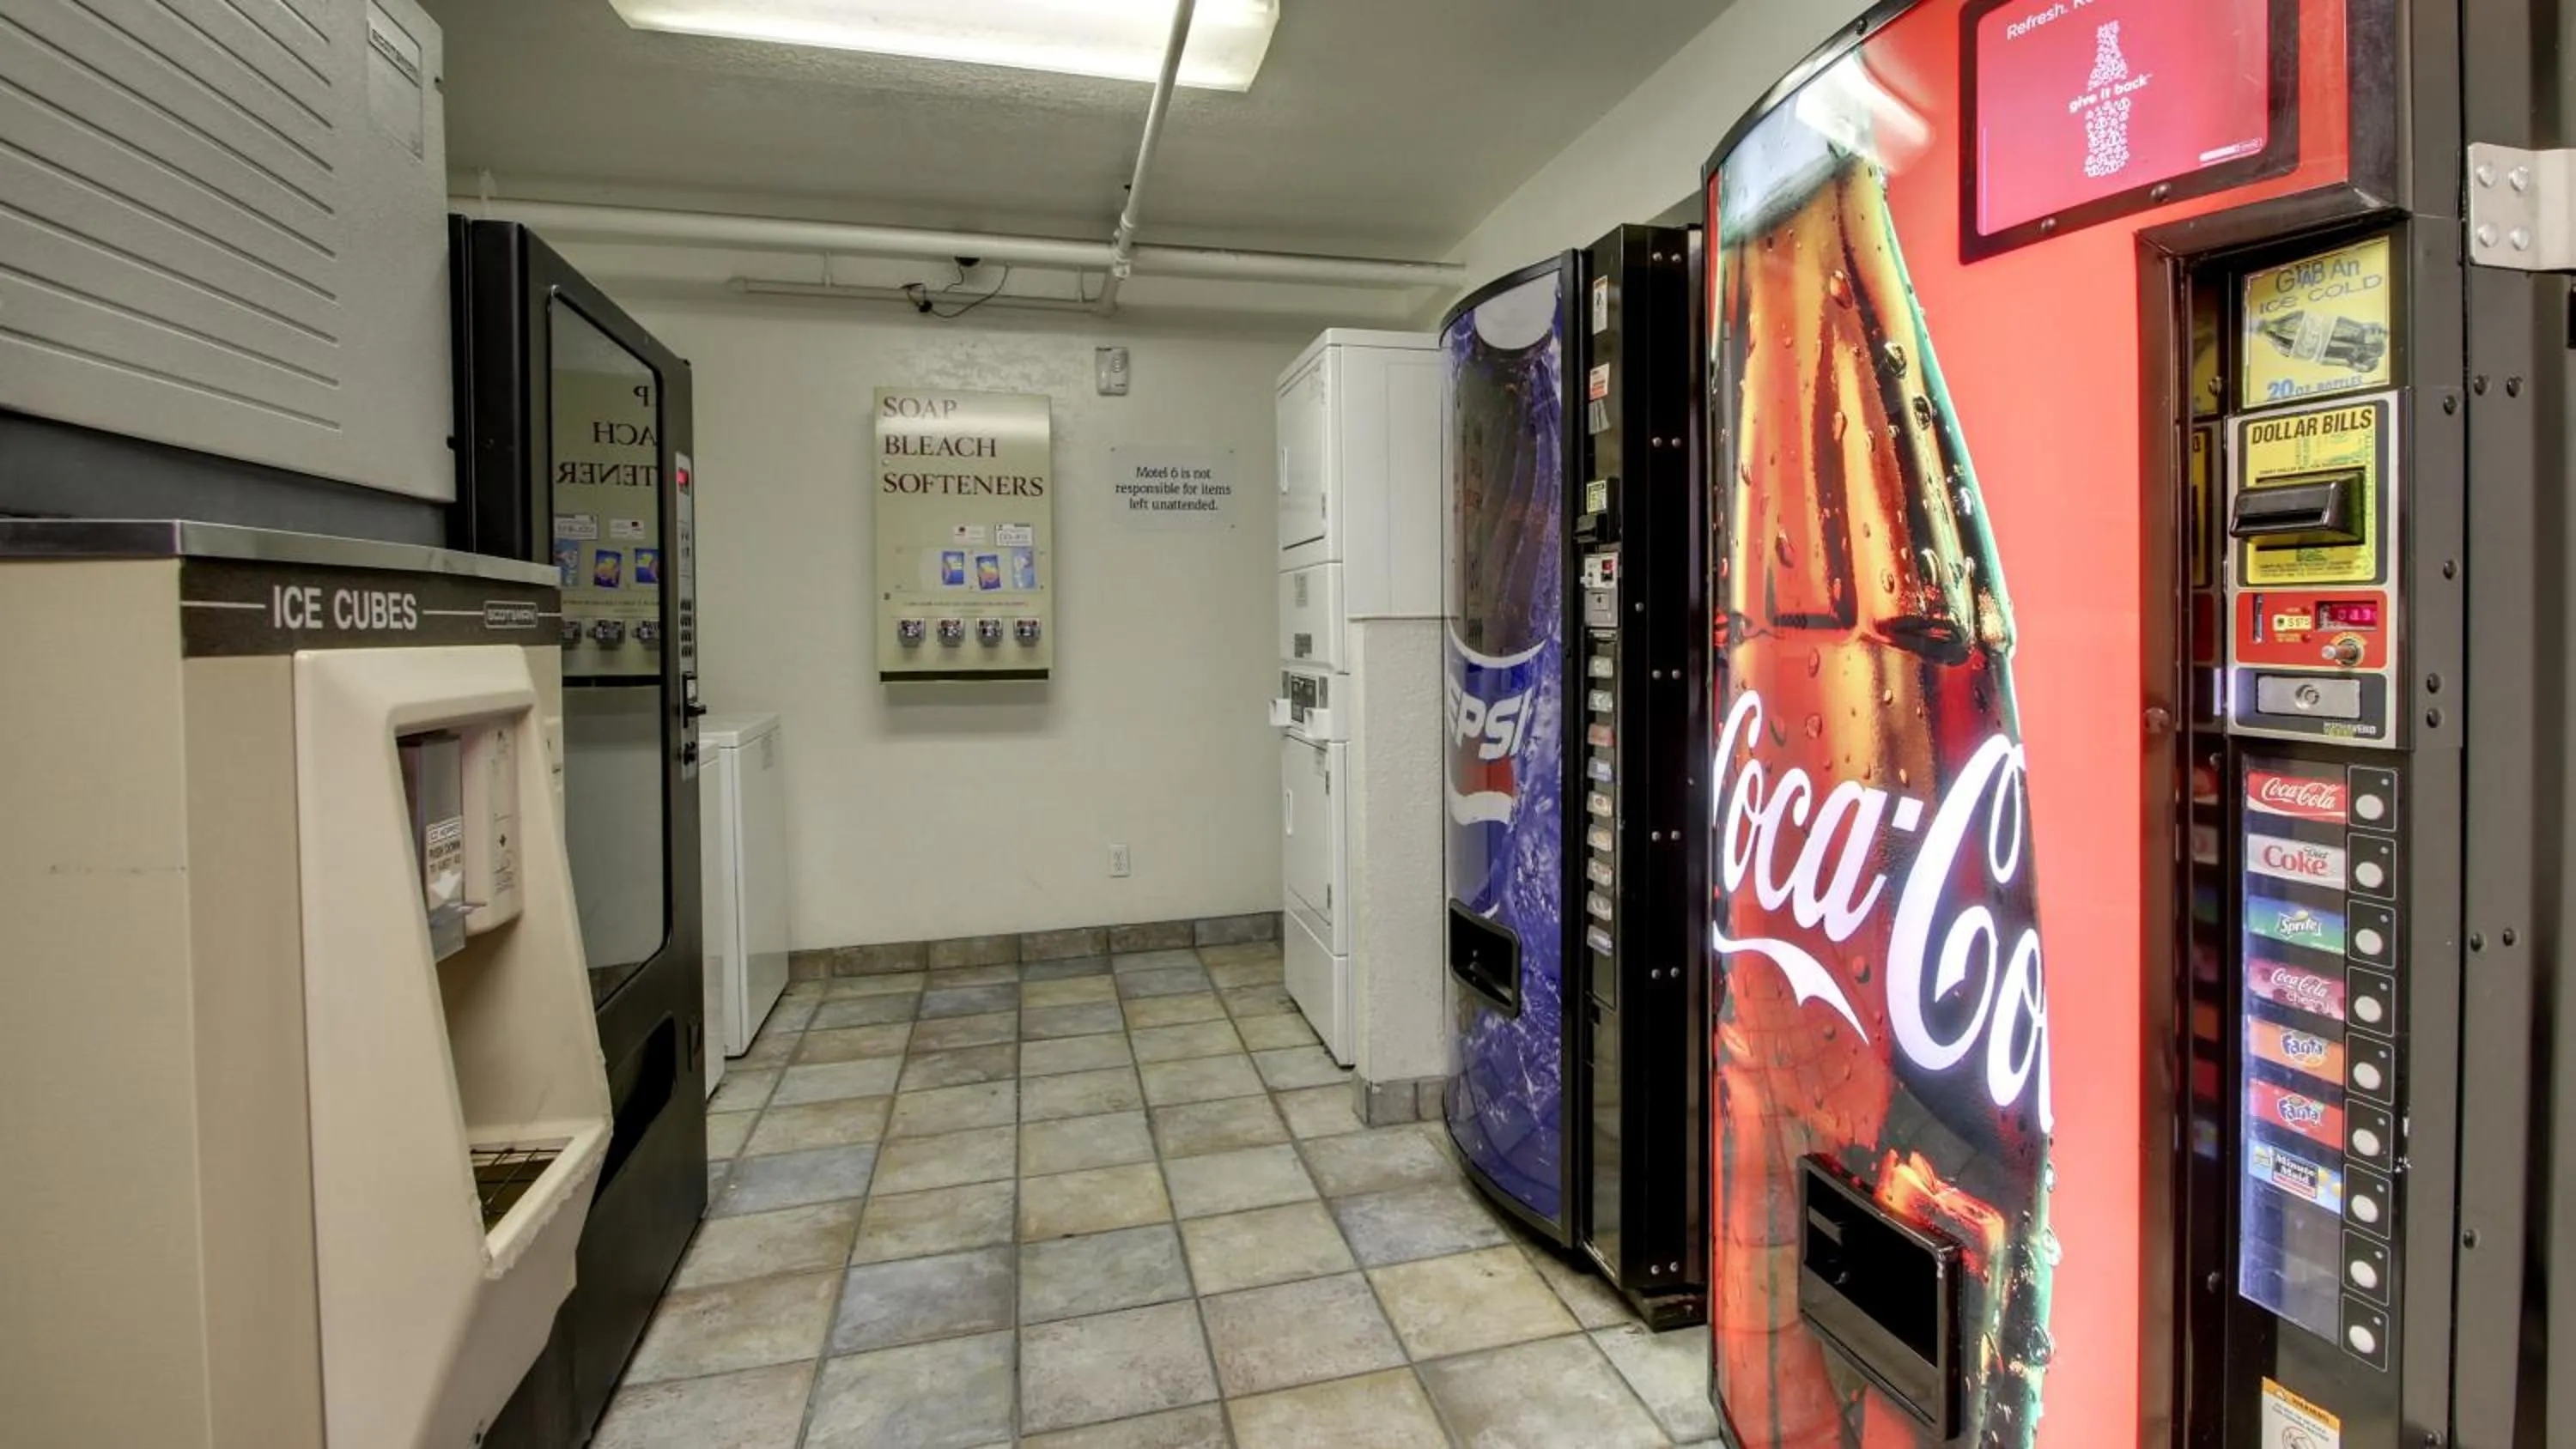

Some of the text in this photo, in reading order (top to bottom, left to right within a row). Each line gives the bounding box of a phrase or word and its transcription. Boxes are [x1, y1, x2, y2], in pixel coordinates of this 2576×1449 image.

[2069, 94, 2097, 113] give
[2100, 87, 2111, 100] it
[2330, 259, 2360, 281] An
[2267, 378, 2294, 400] 20
[883, 396, 957, 419] SOAP
[2251, 408, 2372, 445] DOLLAR BILLS
[884, 434, 997, 458] BLEACH
[1136, 466, 1212, 479] Motel 6 is not
[883, 472, 1044, 497] SOFTENERS
[1115, 482, 1231, 496] responsible for items
[1129, 498, 1218, 511] left unattended.
[273, 585, 418, 630] ICE CUBES
[2263, 845, 2329, 876] Coke
[2279, 918, 2318, 935] Sprite
[2282, 1037, 2323, 1055] Fanta
[2278, 1100, 2318, 1121] Fanta
[2276, 1153, 2316, 1176] Minute
[2281, 1166, 2310, 1185] Maid
